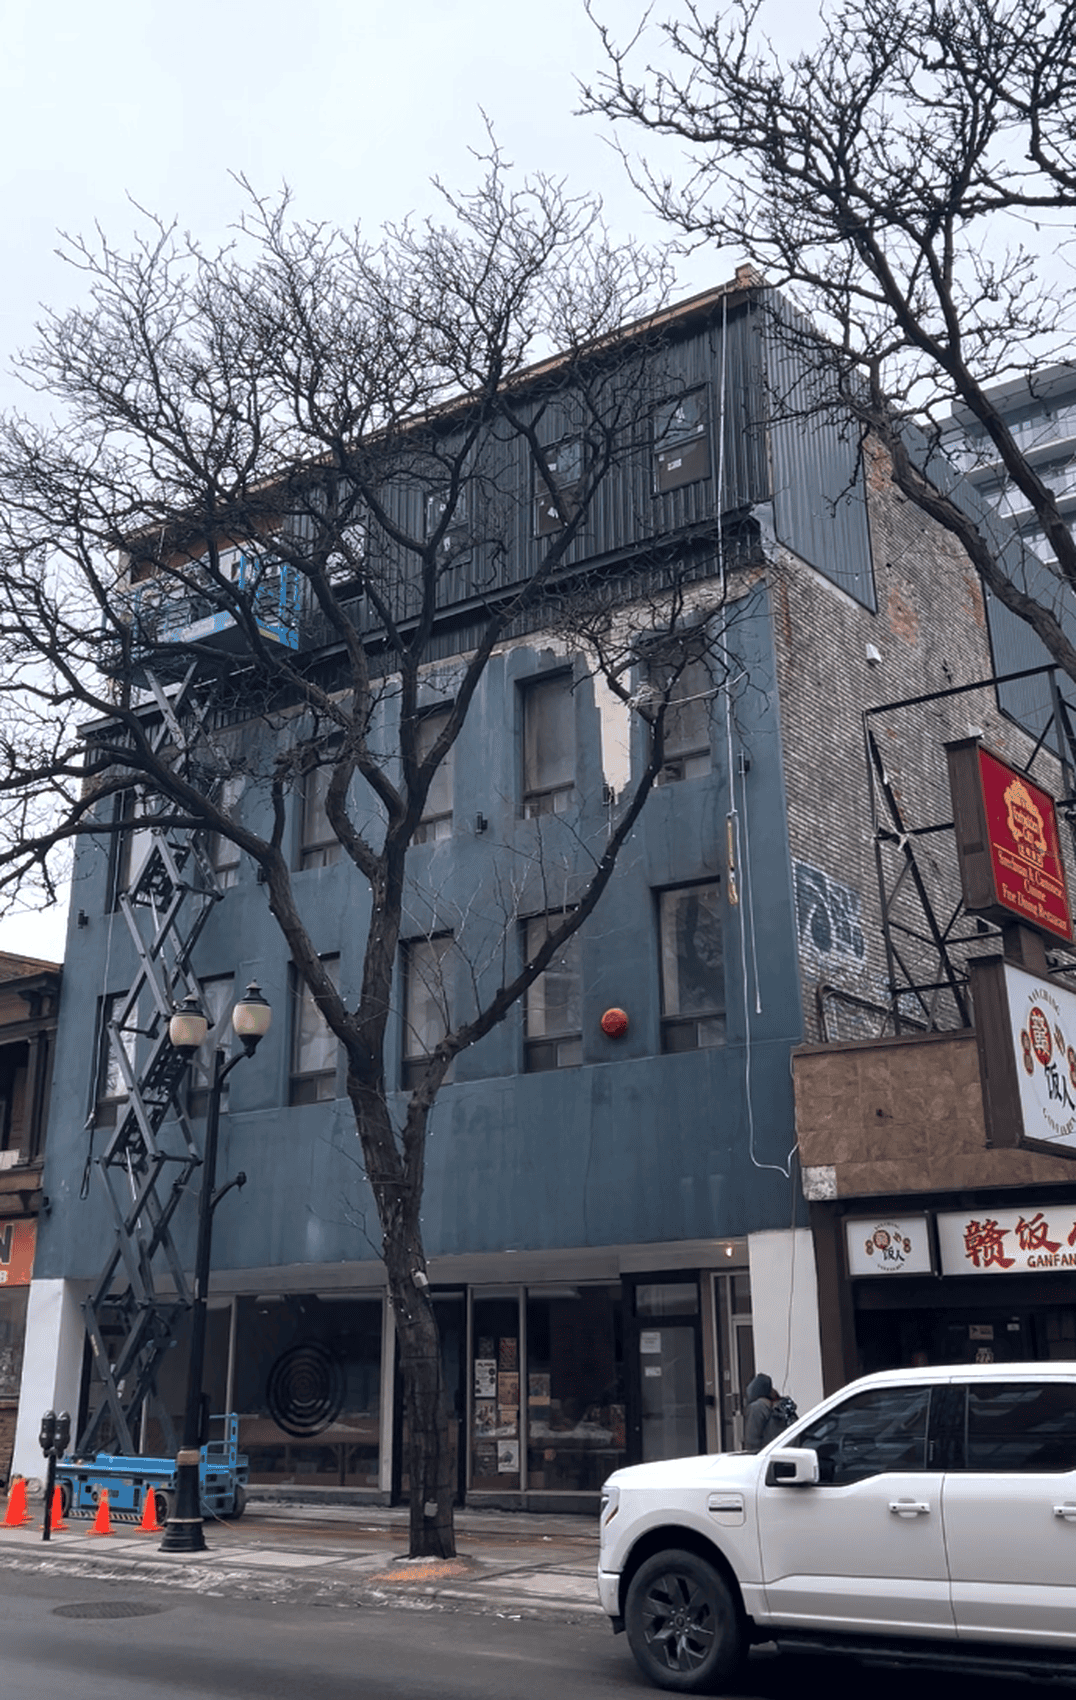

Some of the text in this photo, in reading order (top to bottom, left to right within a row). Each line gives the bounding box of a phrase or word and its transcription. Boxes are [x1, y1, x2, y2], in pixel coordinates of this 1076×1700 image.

[1002, 882, 1068, 931] Fine Dining Restaurant
[1023, 878, 1046, 902] Cuisine
